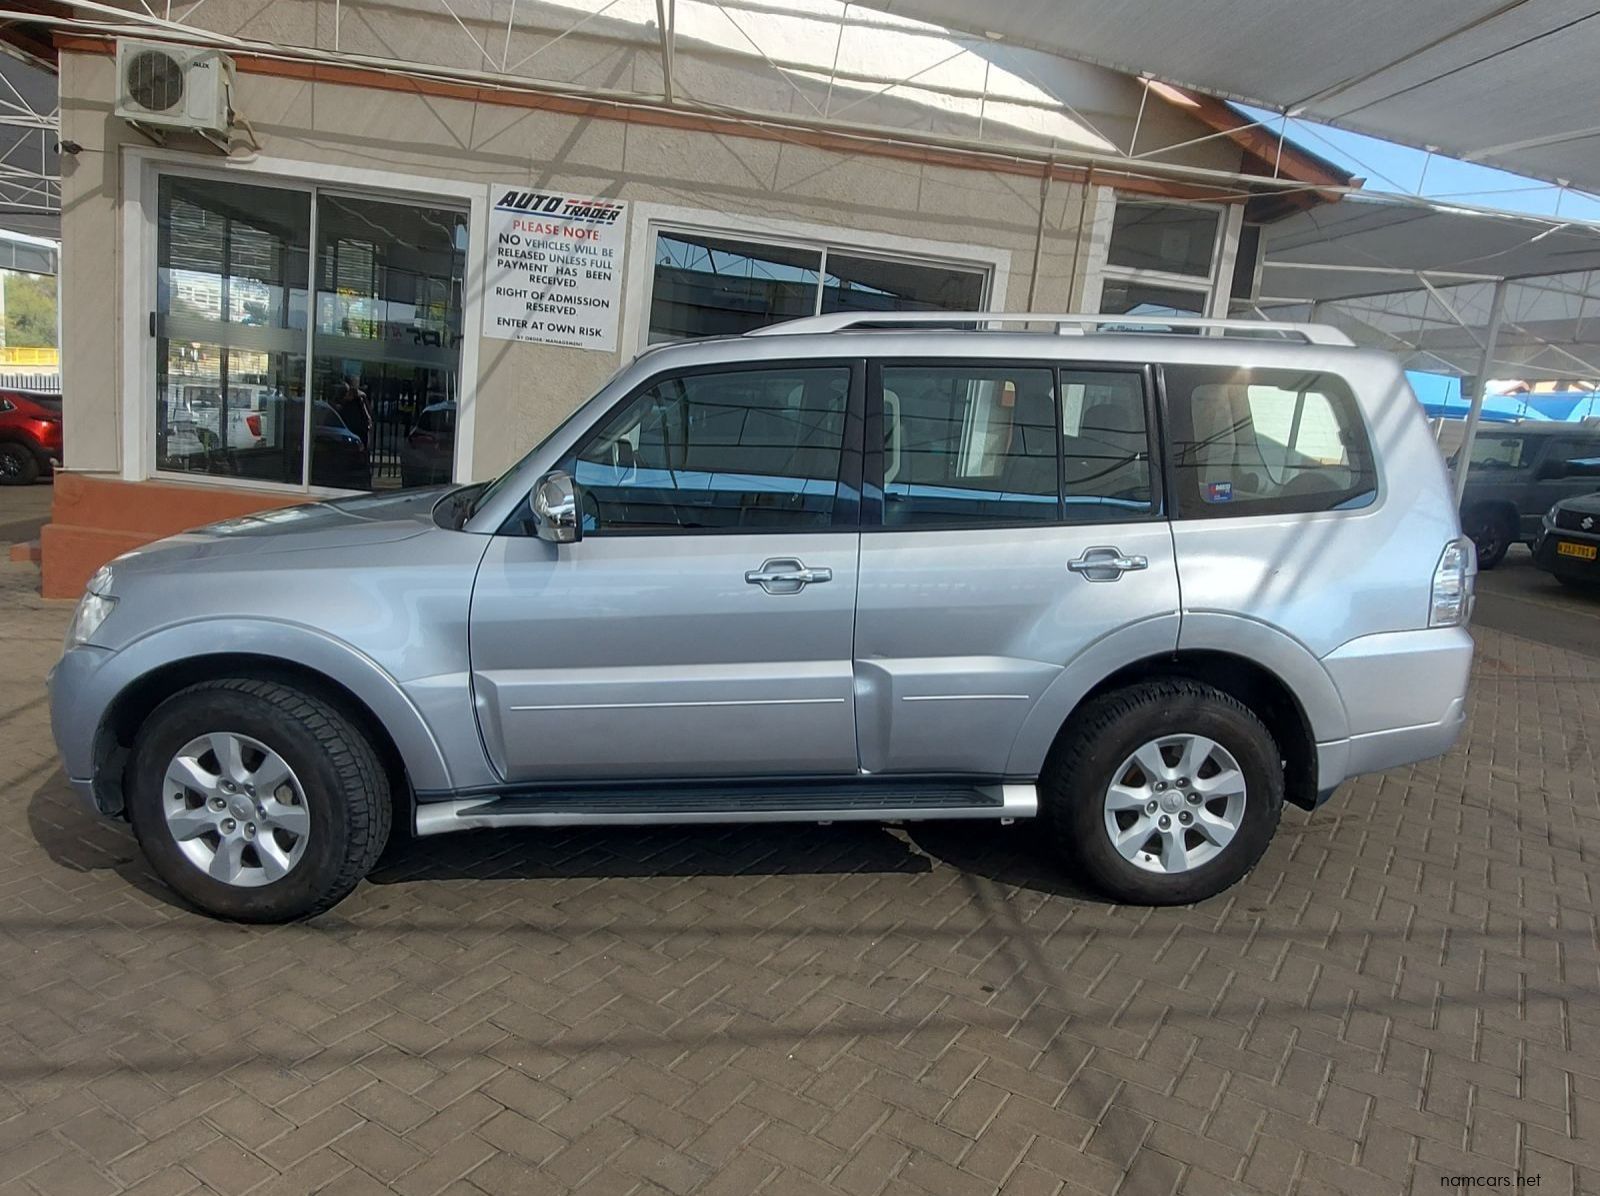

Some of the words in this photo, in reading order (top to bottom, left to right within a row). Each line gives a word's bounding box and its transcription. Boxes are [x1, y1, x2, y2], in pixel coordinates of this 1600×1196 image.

[497, 191, 564, 213] AUTO
[562, 204, 620, 221] TRADER
[513, 220, 559, 235] PLEASE
[563, 226, 599, 240] NOTE
[499, 233, 520, 245] NO
[525, 238, 570, 252] VEHICLES
[574, 245, 597, 256] WILL
[602, 248, 614, 257] BE
[498, 247, 545, 261] RELEASED
[549, 253, 587, 266] UNLESS
[590, 259, 612, 269] FULL
[497, 259, 548, 273] PAYMENT
[556, 266, 578, 276] HAS
[586, 270, 611, 281] BEEN
[496, 286, 527, 299] RIGHT
[531, 291, 545, 300] OF
[548, 293, 609, 308] ADMISSION
[497, 317, 527, 329] ENTER
[531, 321, 544, 331] AT
[547, 323, 575, 335] OWN
